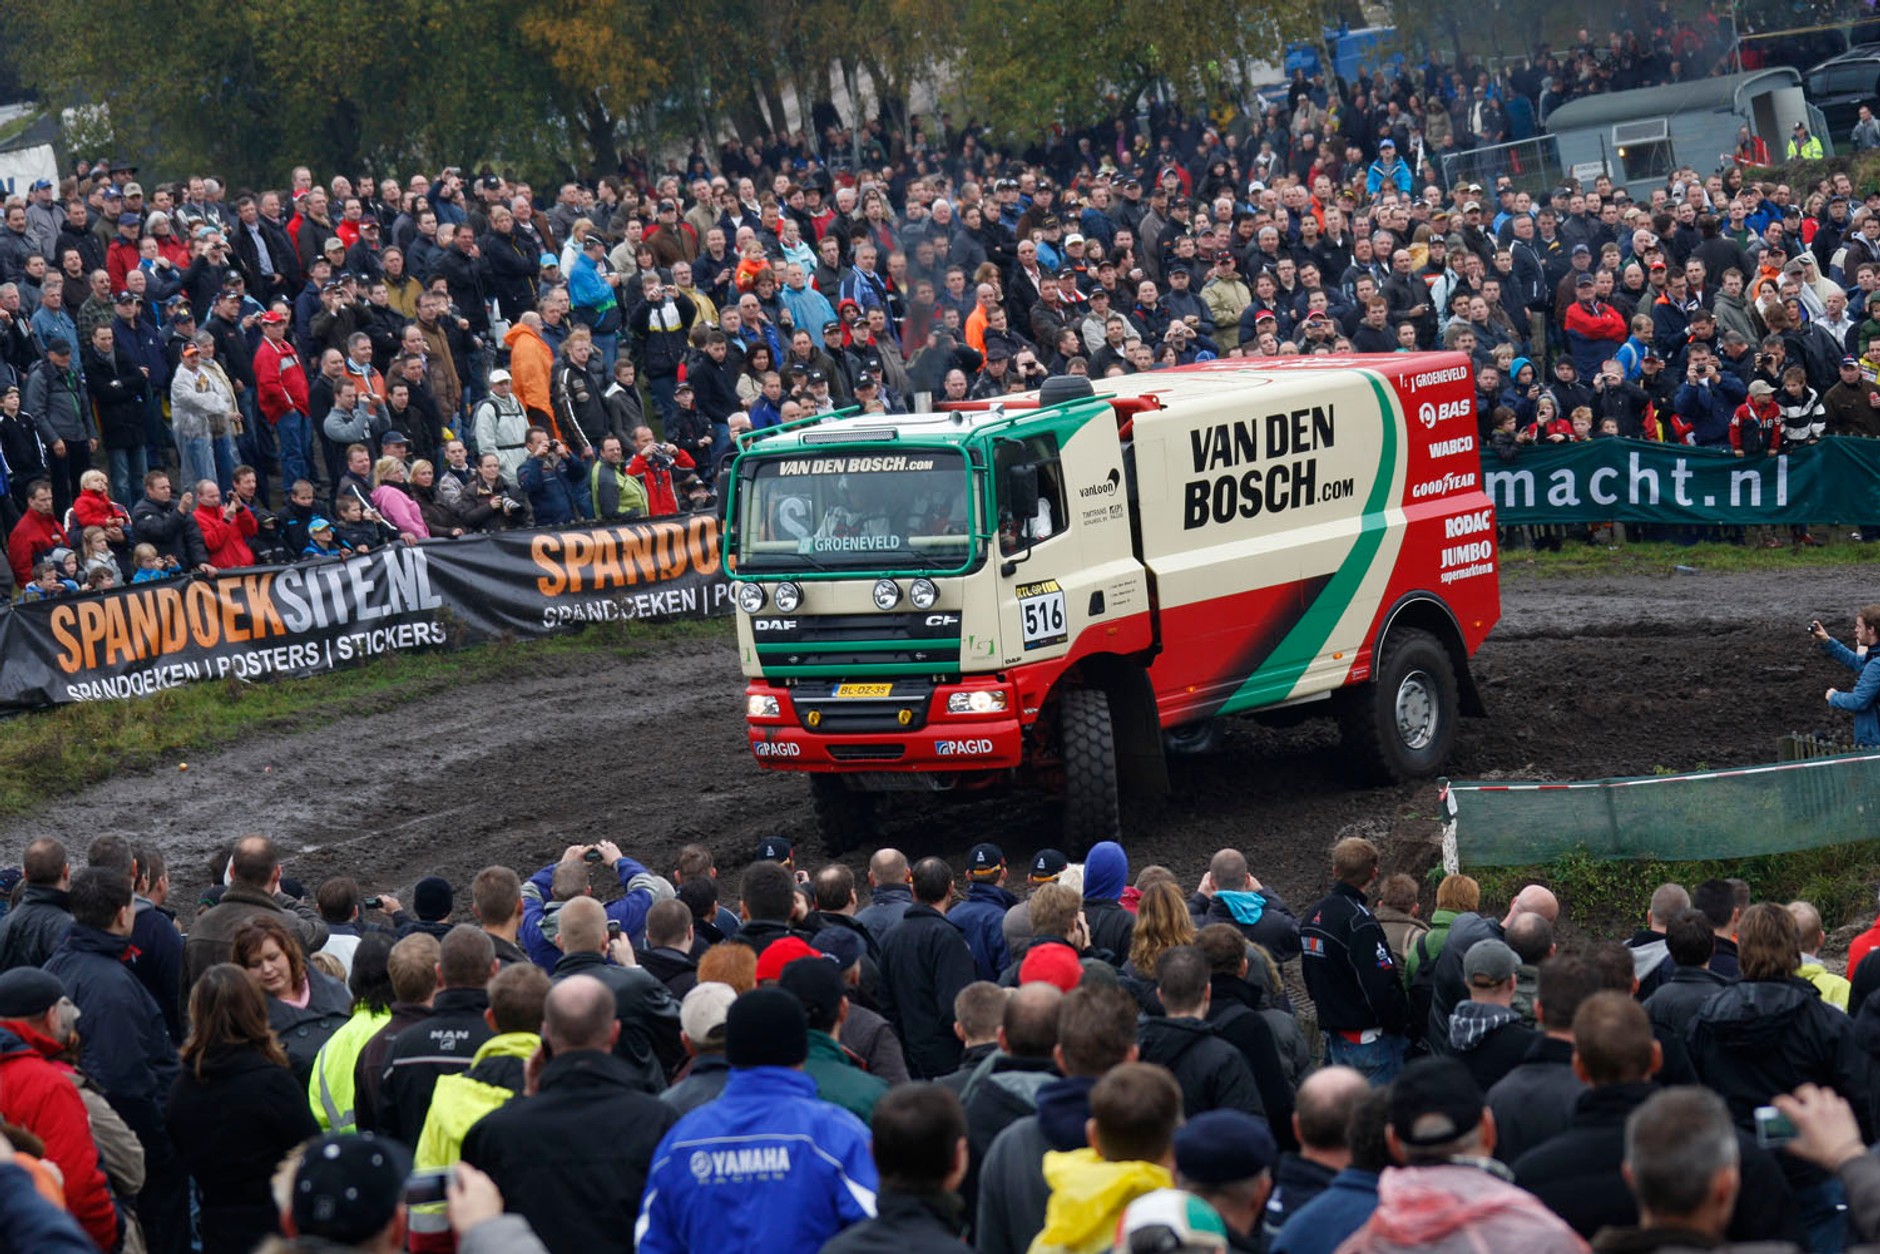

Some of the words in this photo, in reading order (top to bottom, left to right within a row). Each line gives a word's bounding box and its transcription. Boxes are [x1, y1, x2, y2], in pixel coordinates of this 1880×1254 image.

[1416, 366, 1467, 388] GROENEVELD
[1438, 399, 1470, 421] BAS
[1190, 419, 1257, 473] VAN
[1266, 404, 1335, 460] DEN
[1429, 436, 1473, 459] WABCO
[780, 460, 811, 476] VAN
[811, 459, 846, 474] DEN
[1412, 472, 1475, 498] GOODYEAR
[1484, 451, 1788, 507] macht.nl
[1445, 510, 1491, 539] RODAC
[815, 535, 900, 551] GROENEVELD
[1440, 540, 1492, 569] JUMBO
[1440, 565, 1490, 585] supermarkten
[543, 588, 697, 628] SPANDOEKEN
[1025, 599, 1063, 635] 516
[755, 619, 798, 631] DAF
[925, 615, 959, 627] CF
[67, 660, 200, 701] SPANDOEKEN
[217, 641, 320, 678] POSTERS
[336, 621, 447, 660] STICKERS
[840, 686, 888, 695] BL-DZ-35
[763, 742, 801, 757] PAGID
[948, 739, 993, 755] PAGID
[430, 1030, 469, 1040] MAN
[711, 1146, 791, 1176] YAMAHA
